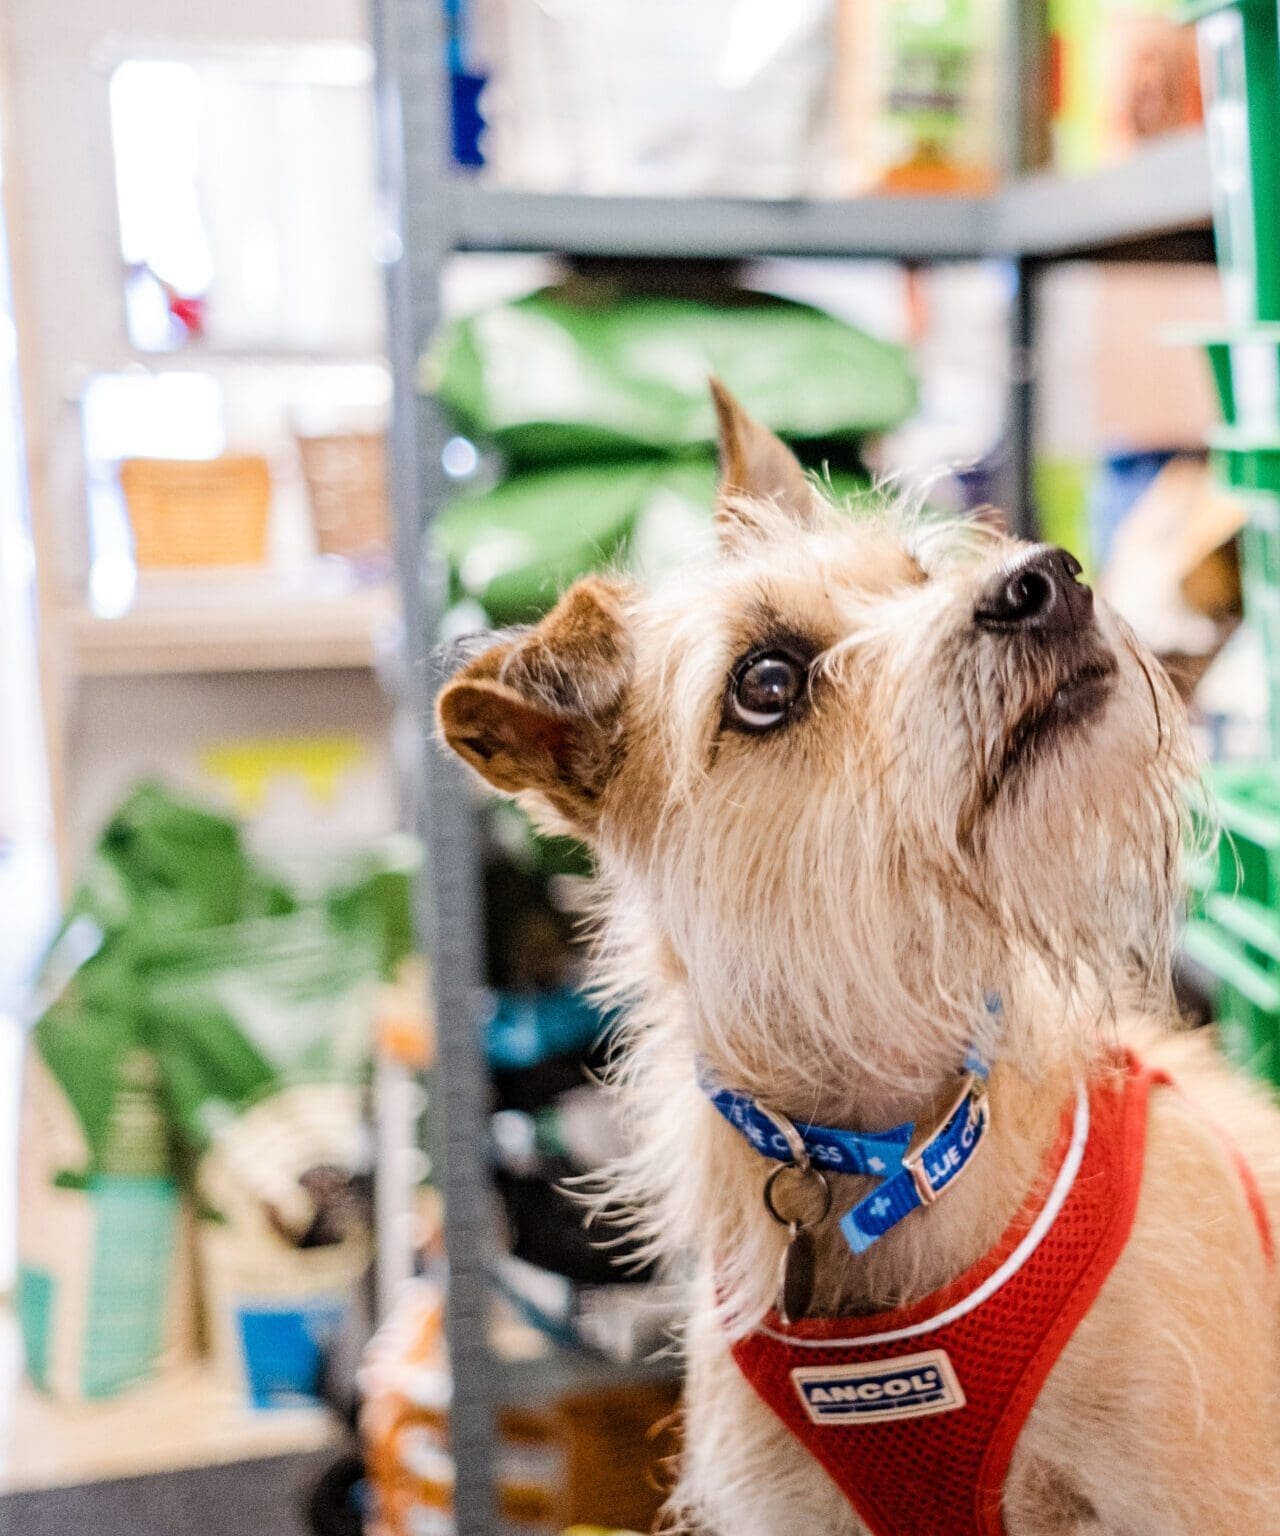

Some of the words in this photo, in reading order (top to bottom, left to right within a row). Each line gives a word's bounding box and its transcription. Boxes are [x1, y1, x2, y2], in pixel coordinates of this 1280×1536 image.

[770, 1133, 843, 1163] CSS
[924, 1144, 962, 1185] LUE
[810, 1369, 938, 1404] ANCOL
